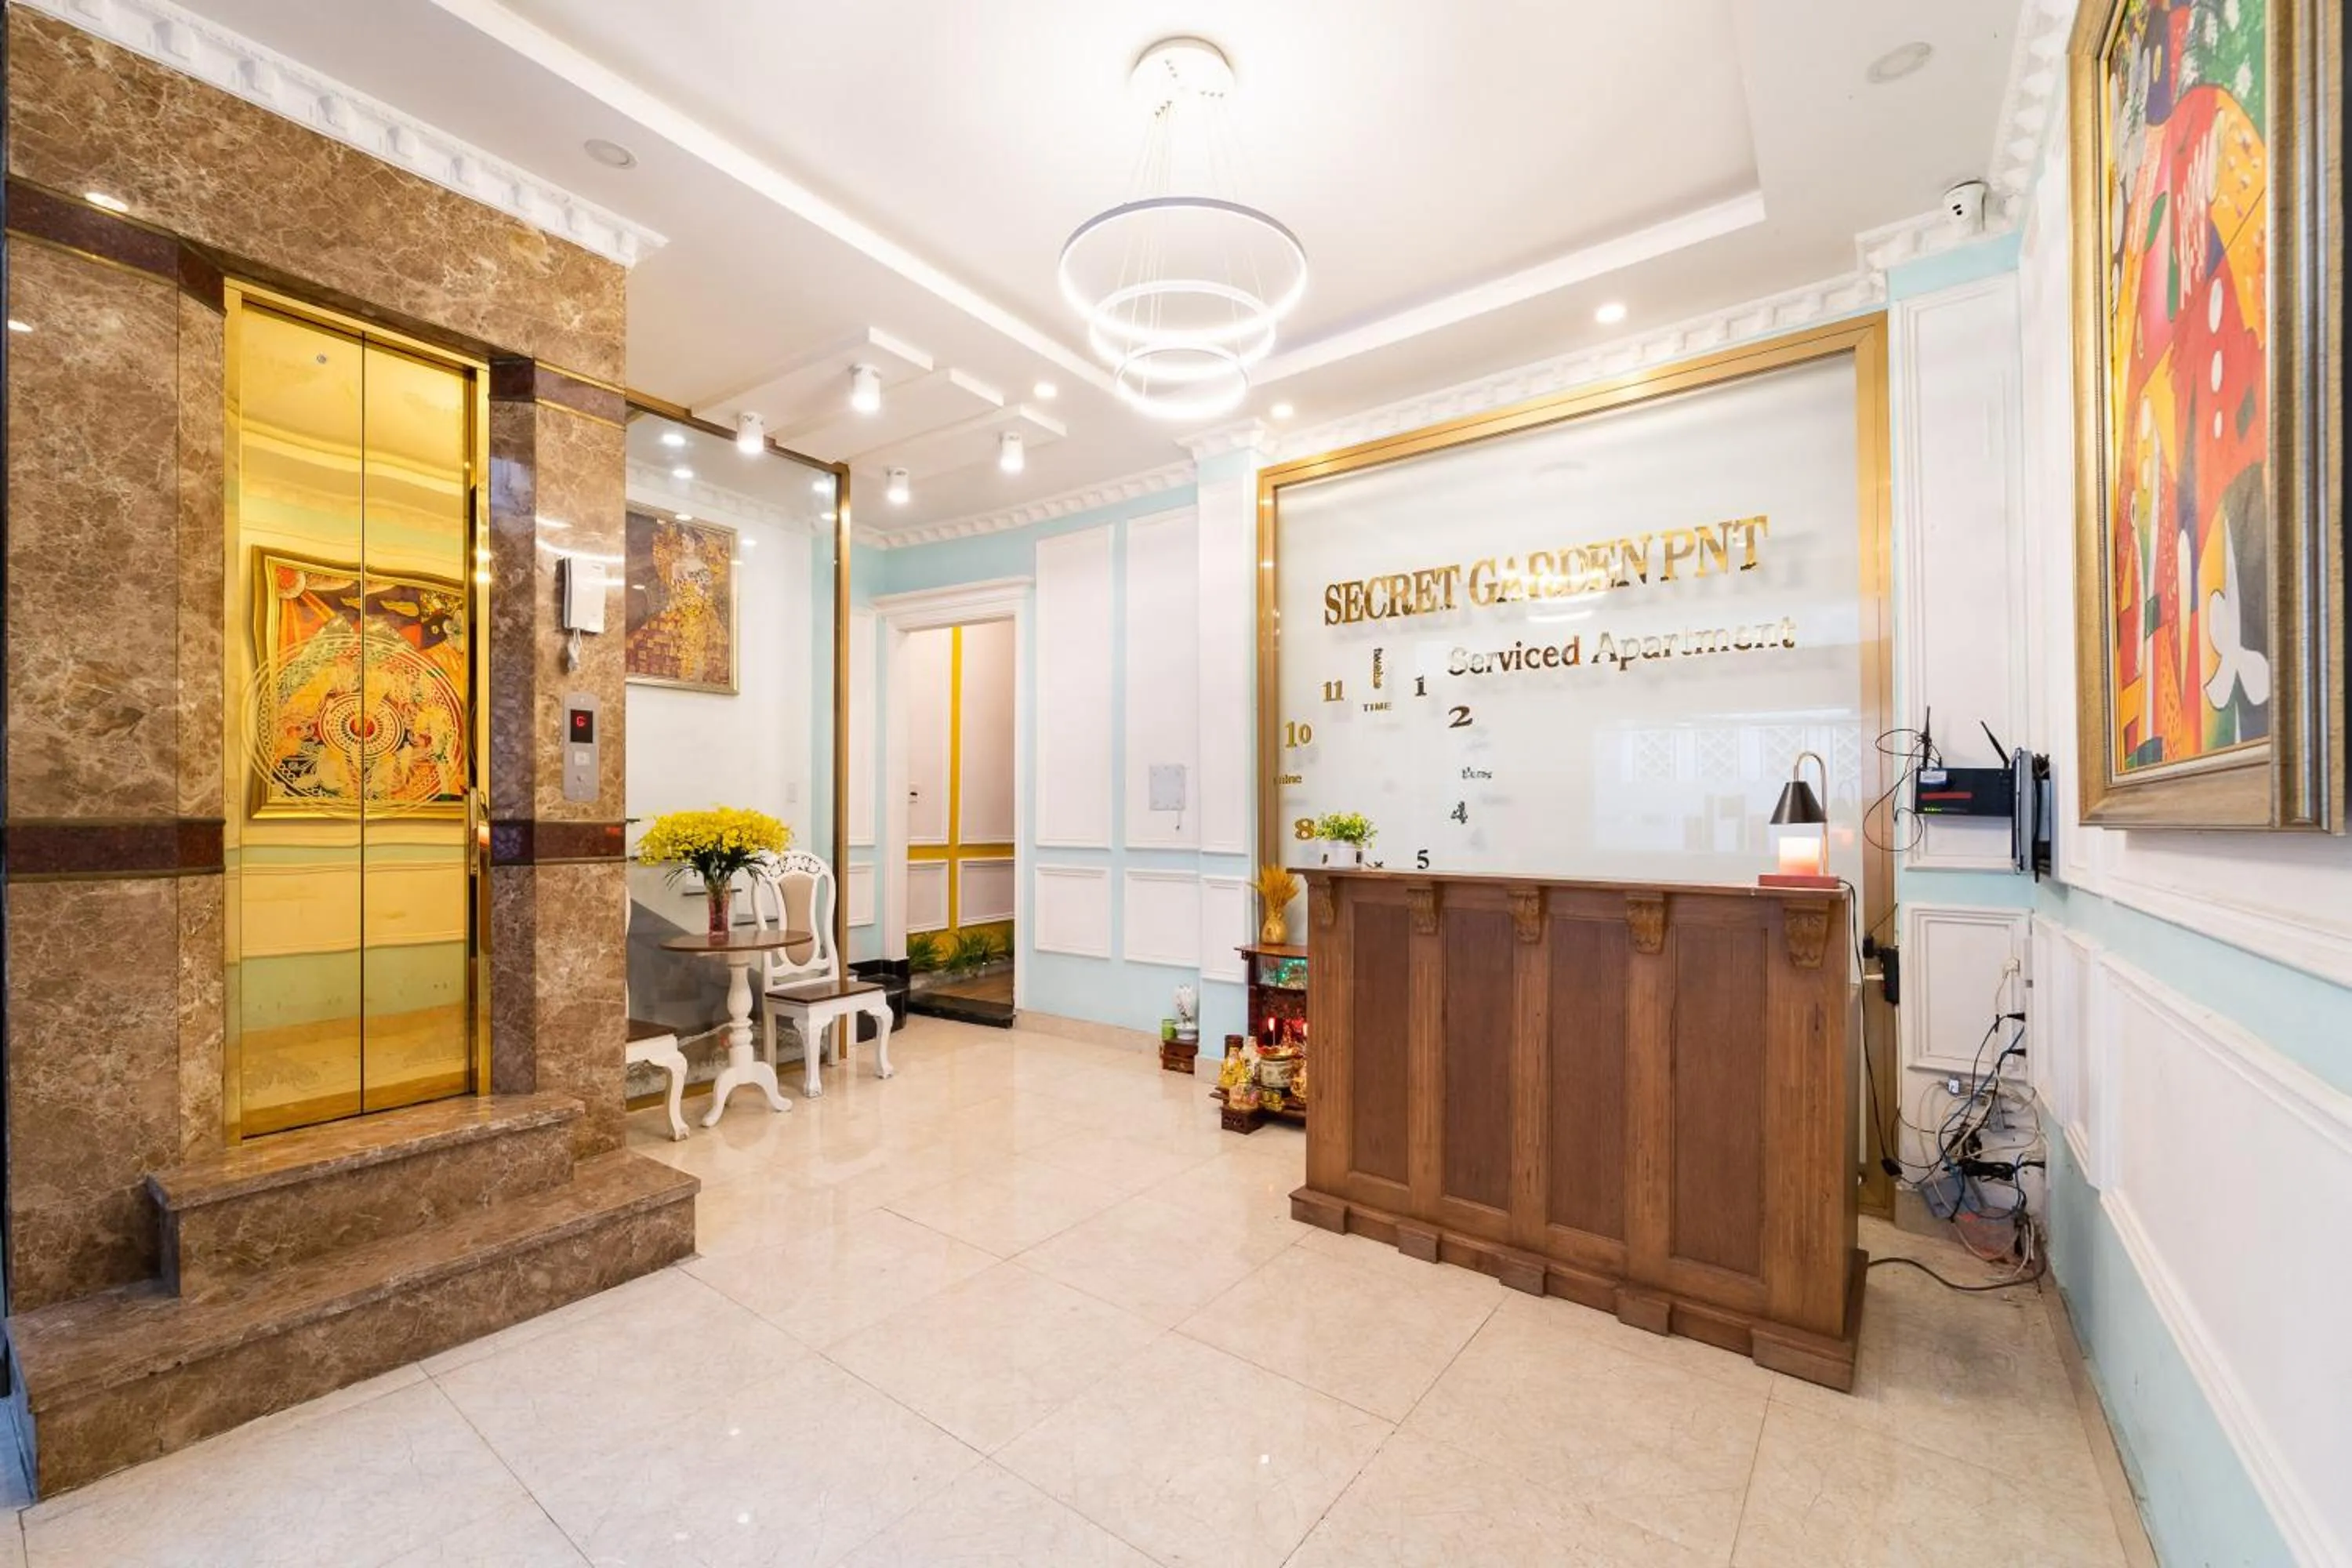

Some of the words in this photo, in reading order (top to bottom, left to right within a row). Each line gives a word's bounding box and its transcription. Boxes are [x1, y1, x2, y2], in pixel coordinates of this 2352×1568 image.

[1324, 564, 1461, 626] SECRET
[1468, 533, 1653, 606] GARDEN
[1659, 514, 1769, 582] PNT
[1447, 635, 1581, 676] Serviced
[1591, 616, 1797, 671] Apartment
[1323, 680, 1345, 702] 11
[1414, 675, 1428, 697] 1
[1363, 702, 1392, 712] TIME
[1447, 705, 1473, 728] 2
[1284, 721, 1312, 748] 10
[1450, 800, 1468, 825] 4
[1294, 818, 1315, 841] 8
[1416, 848, 1430, 869] 5
